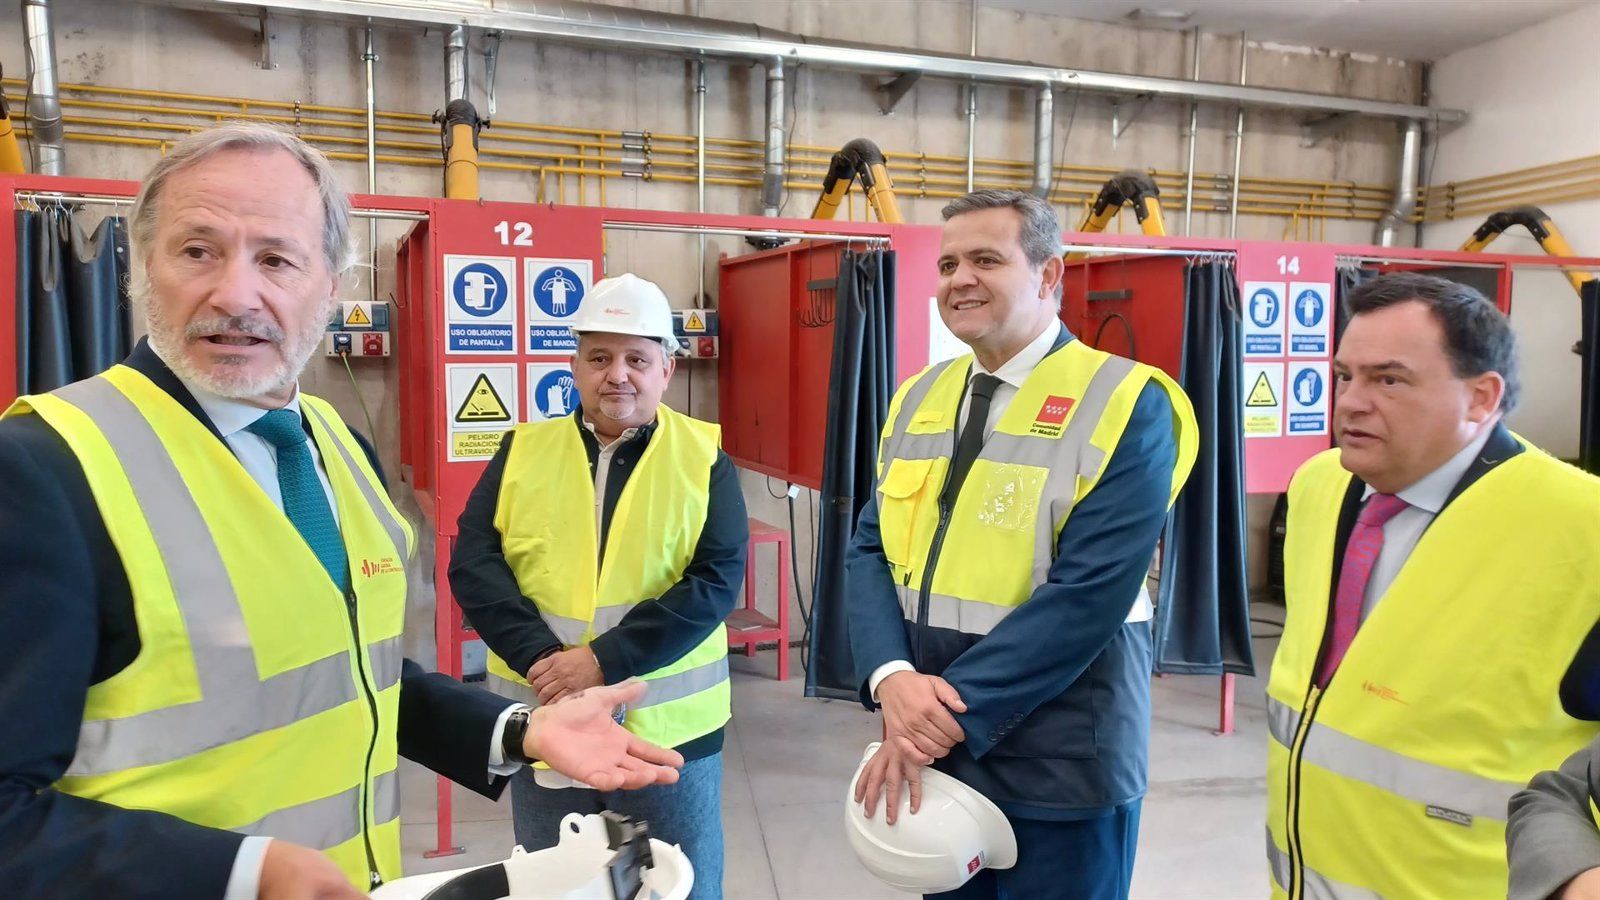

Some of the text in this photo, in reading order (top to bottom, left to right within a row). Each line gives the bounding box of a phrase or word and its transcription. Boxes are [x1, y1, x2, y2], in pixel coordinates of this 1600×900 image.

[494, 220, 533, 246] 12
[1277, 255, 1300, 275] 14
[467, 329, 512, 337] OBLIGATORIO
[531, 329, 545, 337] USO
[459, 338, 504, 347] DE PANTALLA
[543, 339, 552, 347] DE
[1033, 423, 1062, 431] Comunidad
